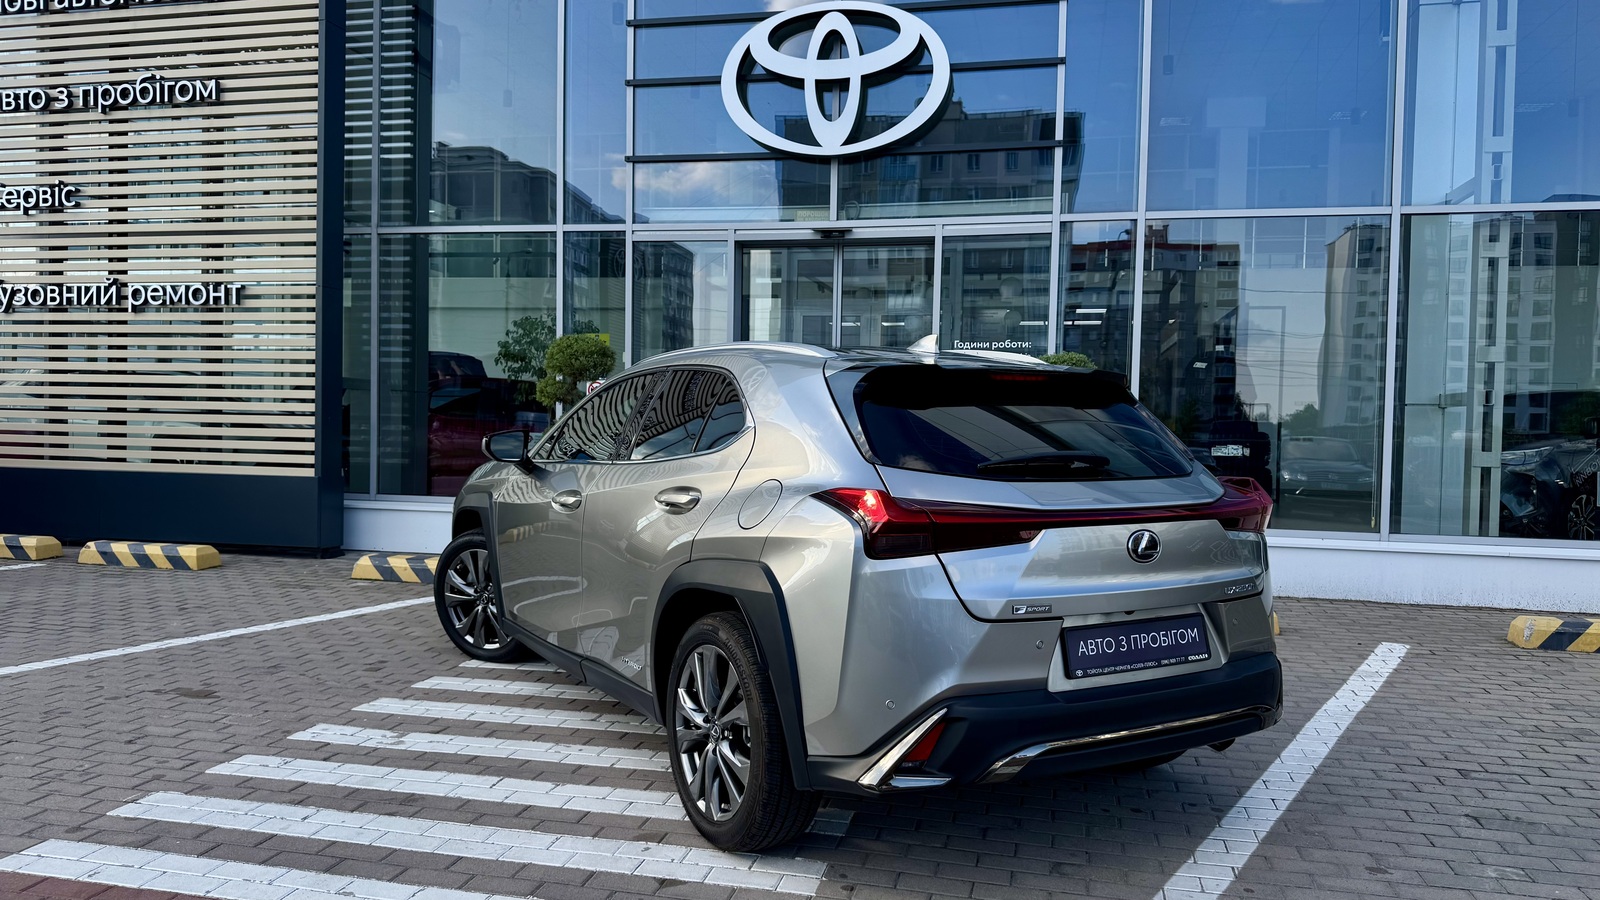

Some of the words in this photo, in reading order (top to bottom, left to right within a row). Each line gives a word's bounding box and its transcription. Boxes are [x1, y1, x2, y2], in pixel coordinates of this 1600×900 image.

[54, 86, 69, 108] з
[80, 73, 216, 112] пробігом
[0, 179, 76, 215] ервіс
[128, 284, 241, 312] ремонт
[954, 340, 990, 350] Години
[992, 339, 1032, 350] роботи:
[1078, 637, 1116, 657] АВТО
[1130, 627, 1199, 650] ПРОБІГОМ
